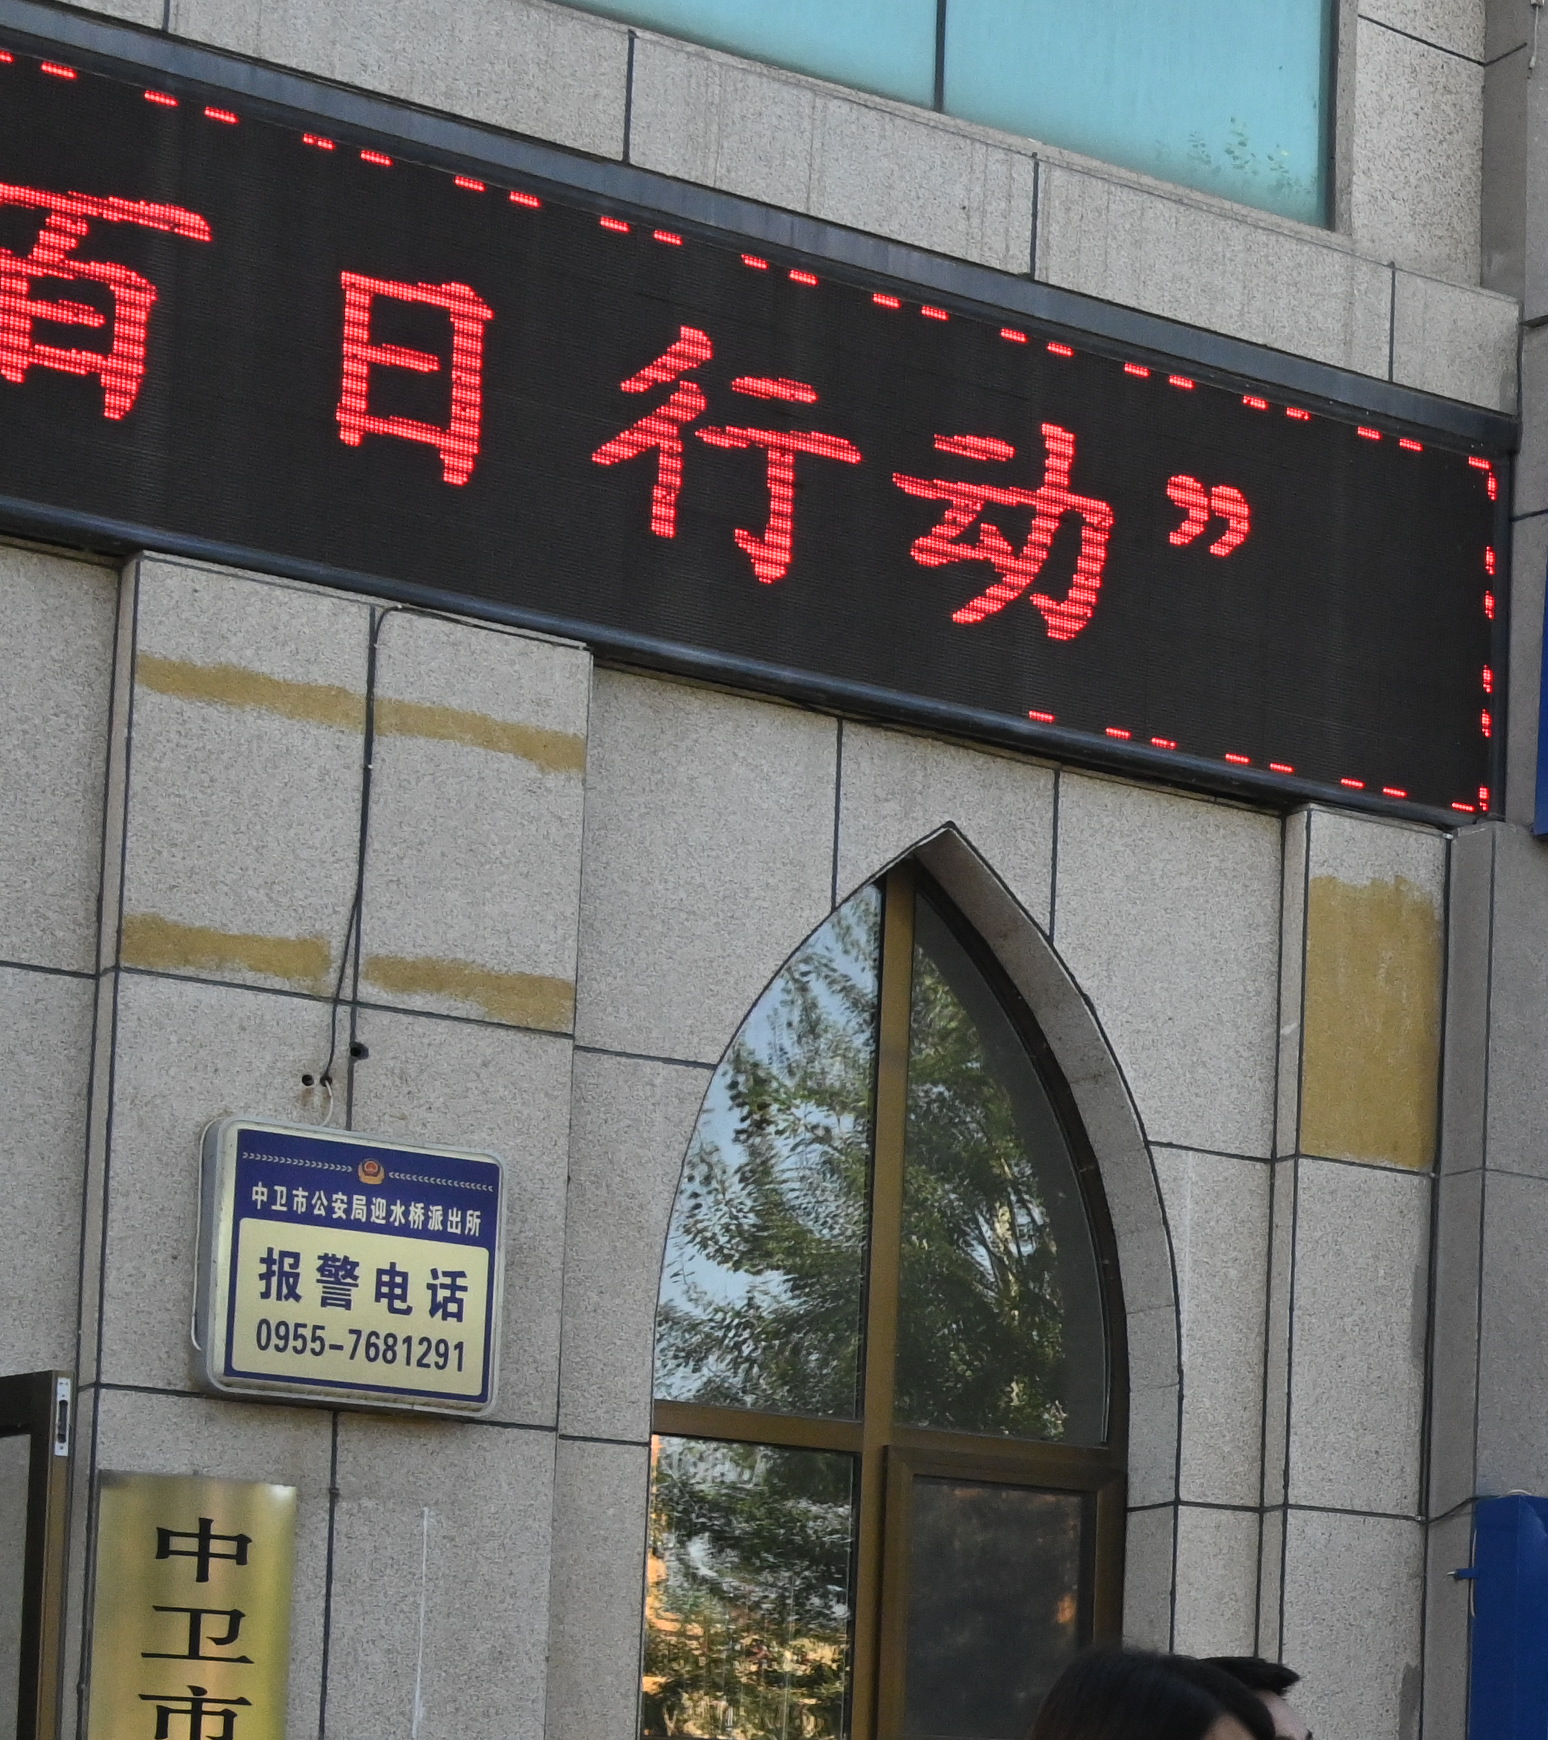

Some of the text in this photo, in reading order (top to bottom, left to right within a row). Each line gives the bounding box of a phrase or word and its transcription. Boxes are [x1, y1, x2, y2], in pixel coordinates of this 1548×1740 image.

[252, 1181, 482, 1238] 中卫市公安局迎水桥派出所
[258, 1246, 469, 1323] 报警电话
[256, 1318, 465, 1373] 0955-7681291
